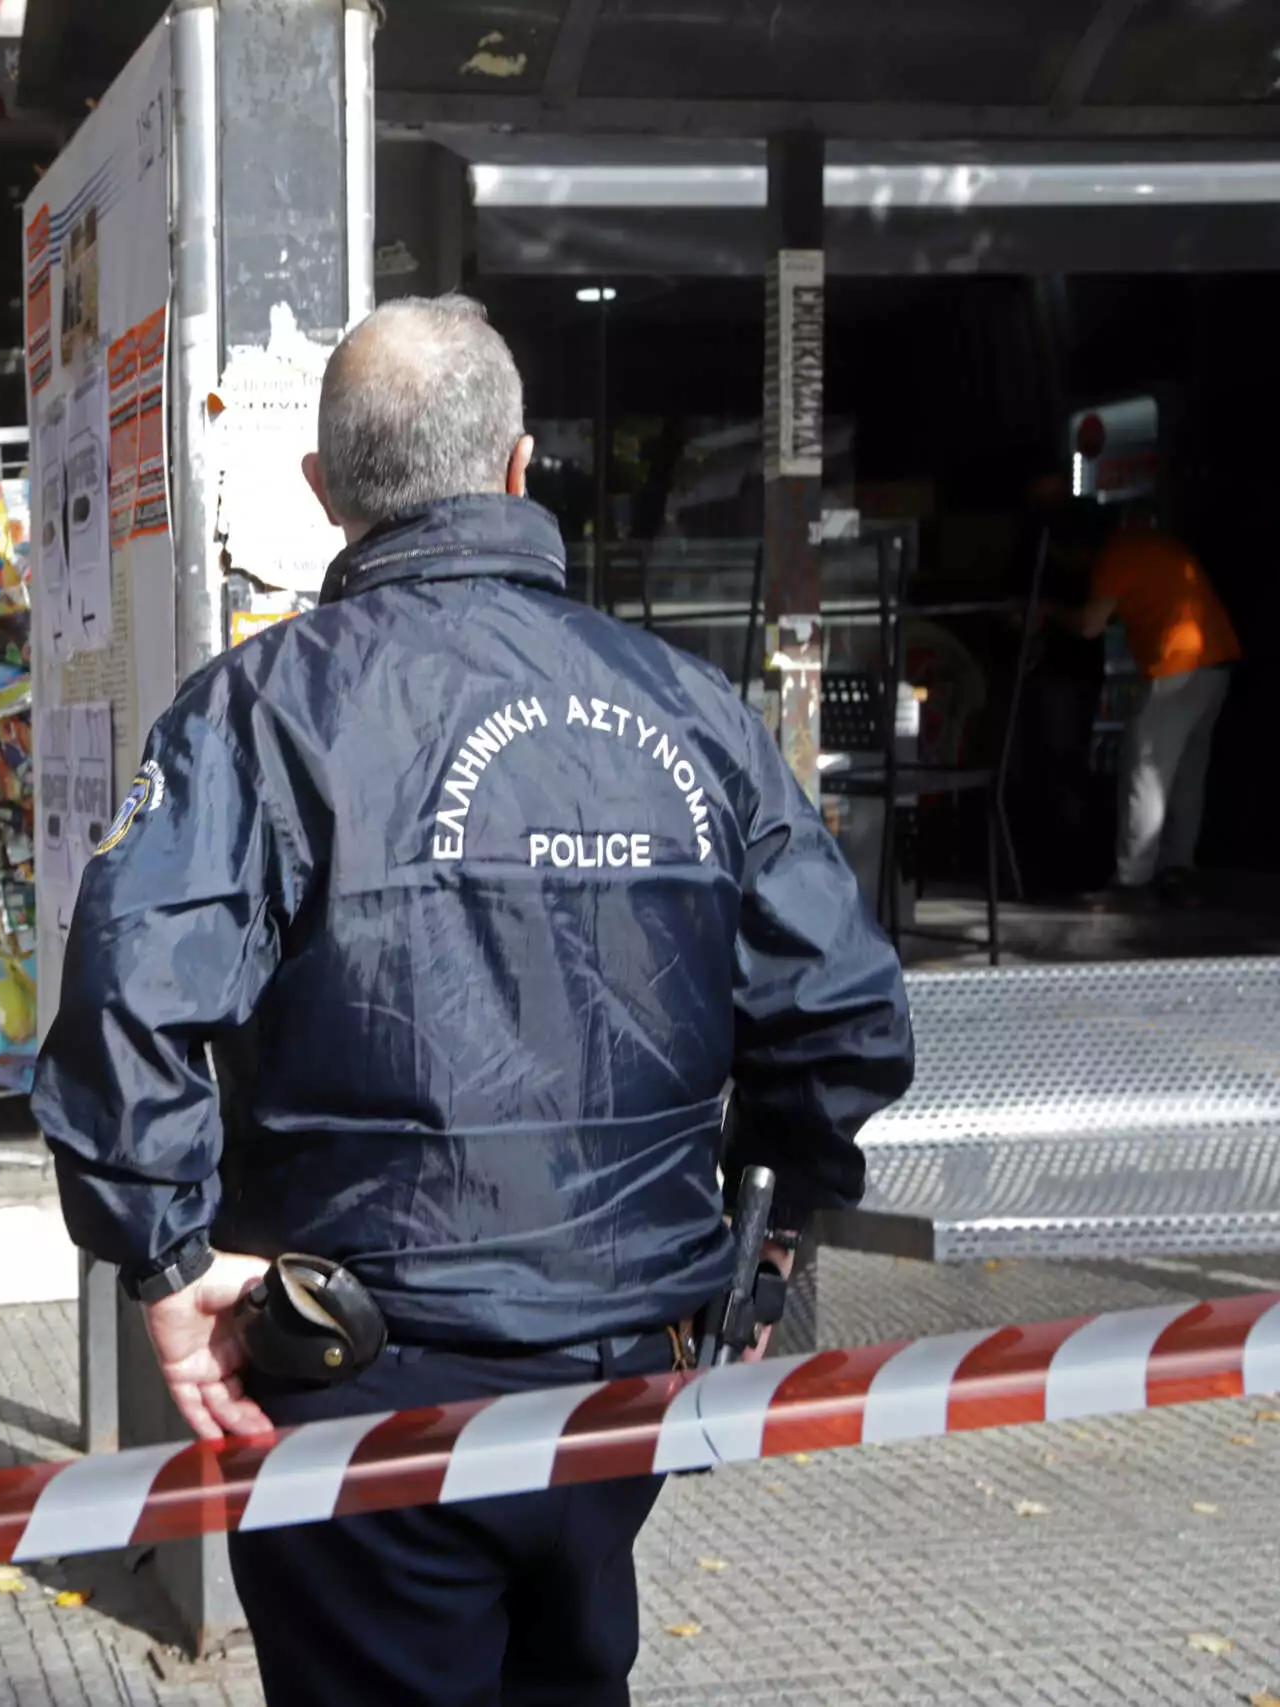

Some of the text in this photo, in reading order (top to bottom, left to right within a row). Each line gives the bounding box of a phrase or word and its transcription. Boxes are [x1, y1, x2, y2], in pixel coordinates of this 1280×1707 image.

[433, 695, 712, 862] ΕΛΛΗΝΙΚΗ ΑΣΤΥΝΟΜΙΑ
[530, 834, 652, 868] POLICE
